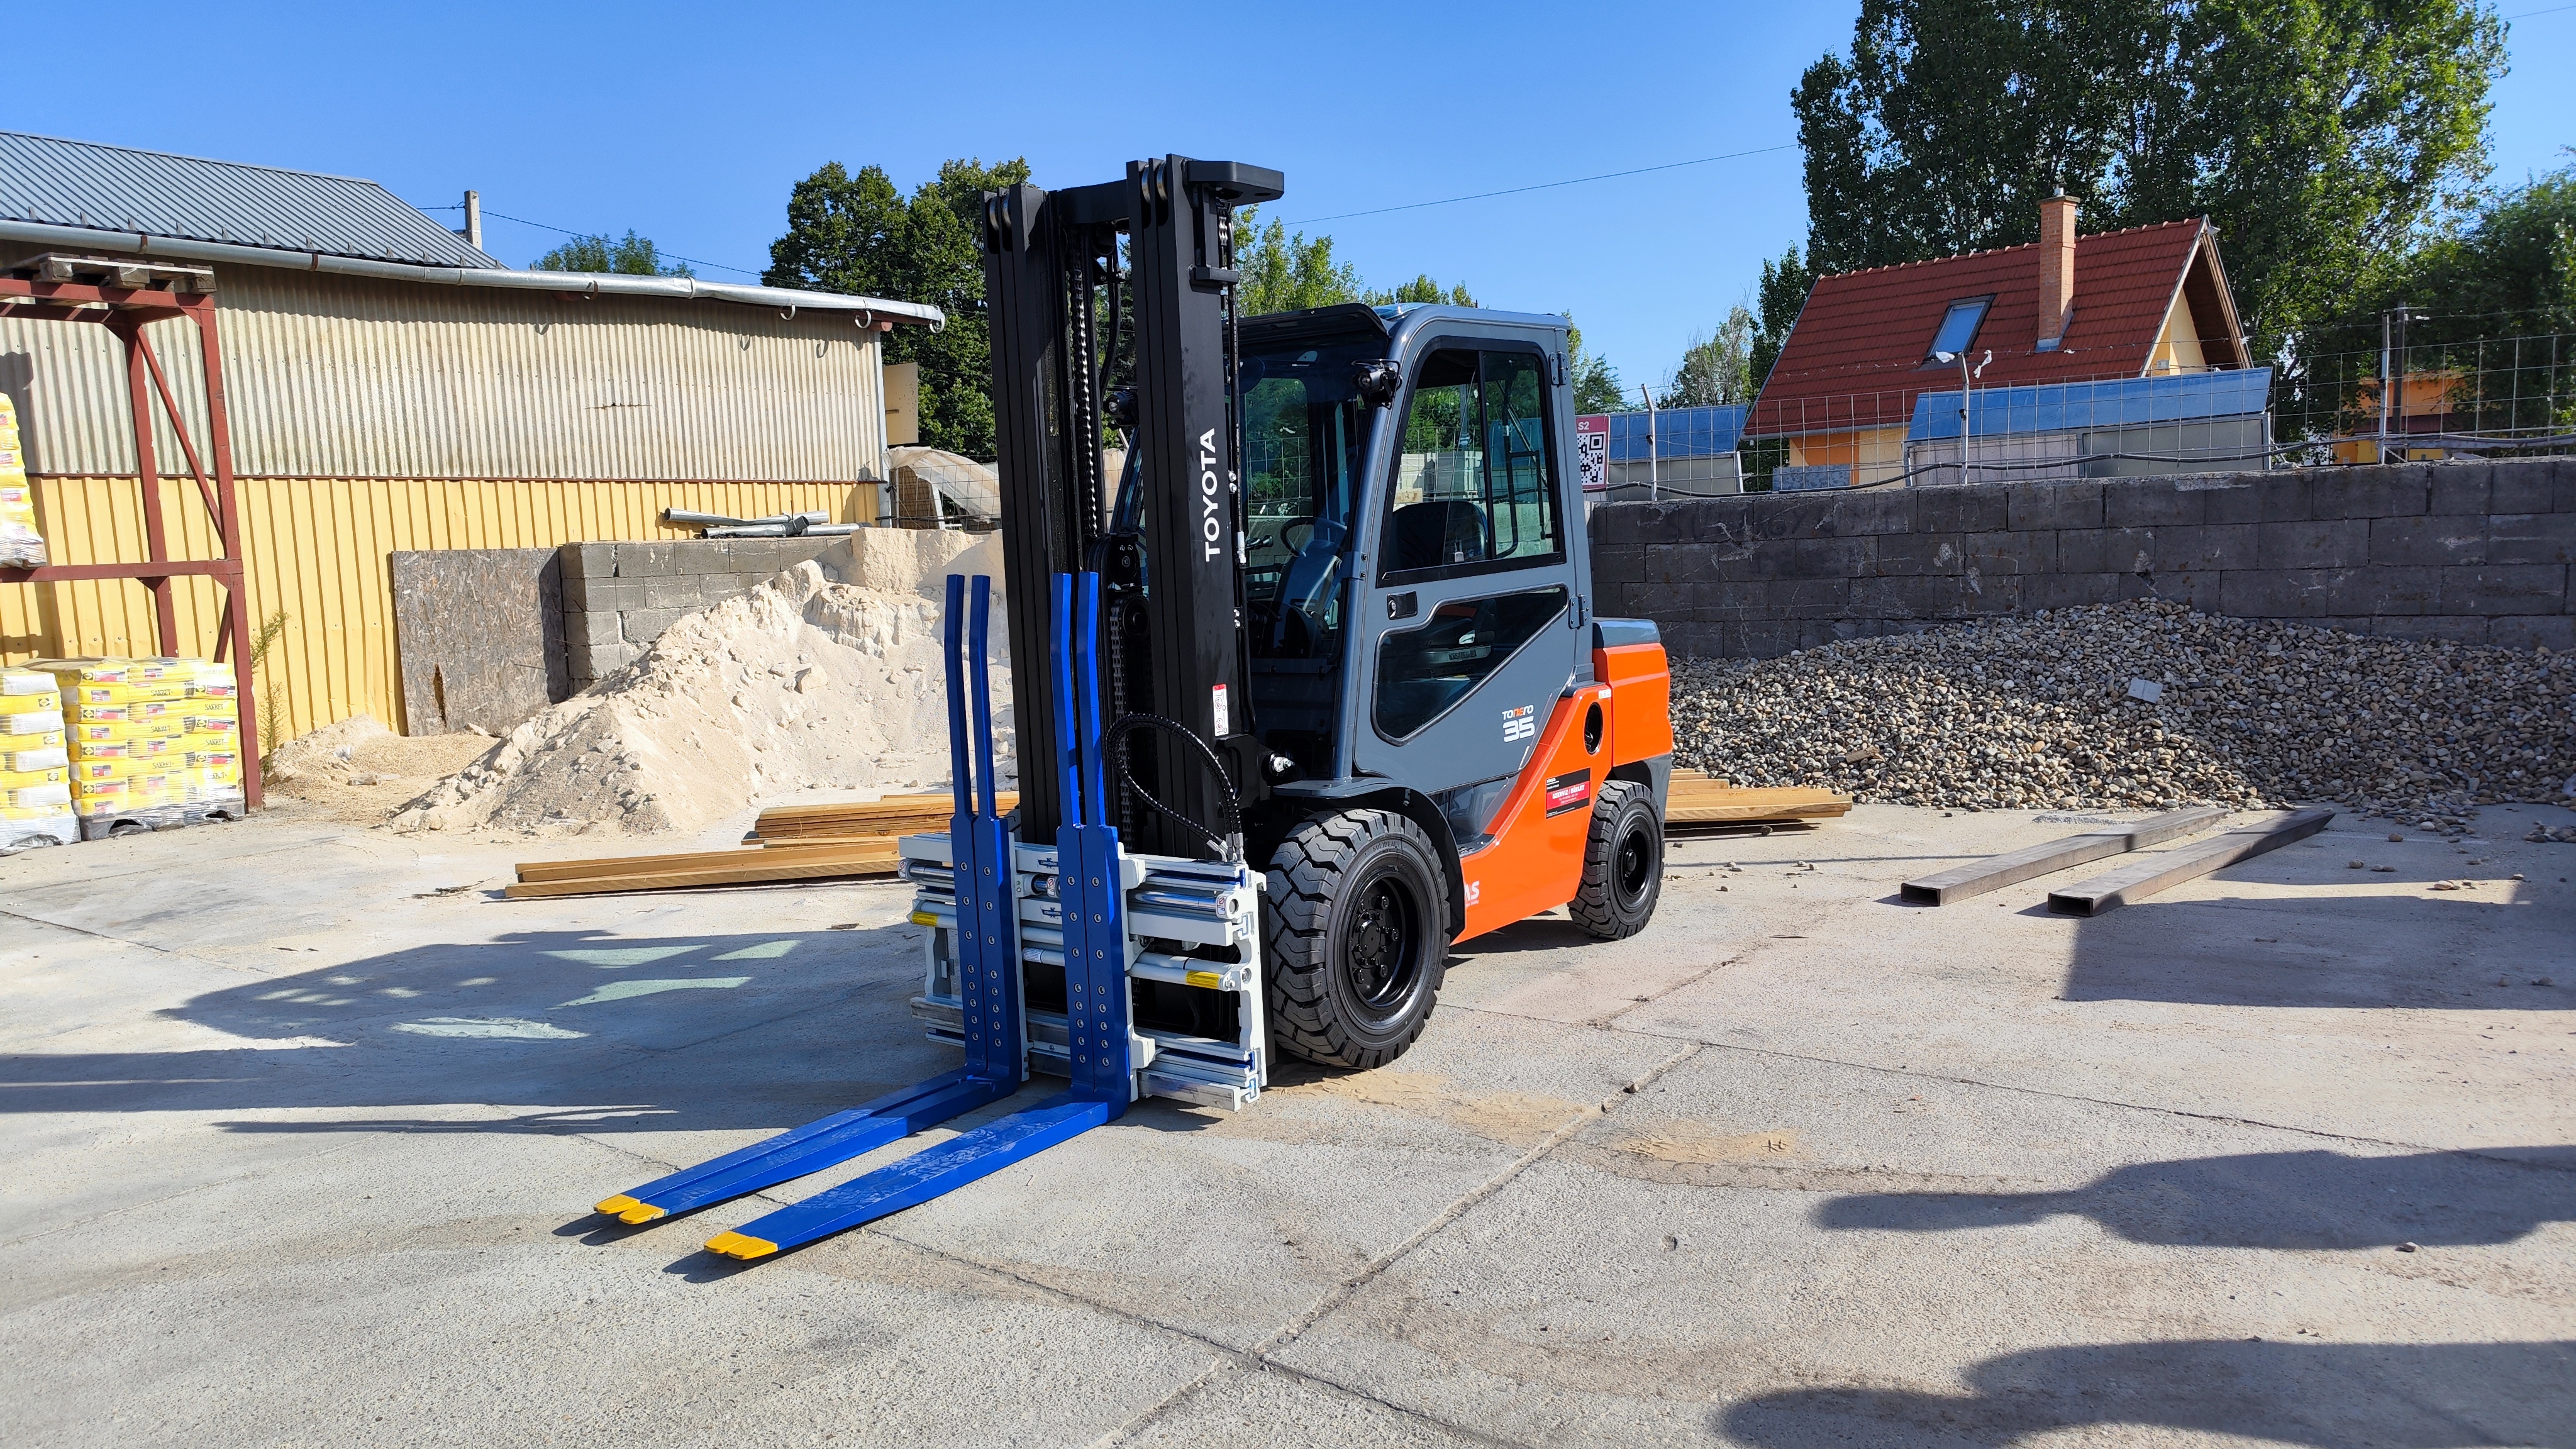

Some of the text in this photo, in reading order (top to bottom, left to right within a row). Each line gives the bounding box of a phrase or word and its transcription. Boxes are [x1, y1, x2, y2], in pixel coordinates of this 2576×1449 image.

[1578, 421, 1590, 430] S2
[1200, 428, 1220, 562] TOYOTA
[1502, 716, 1535, 743] 35
